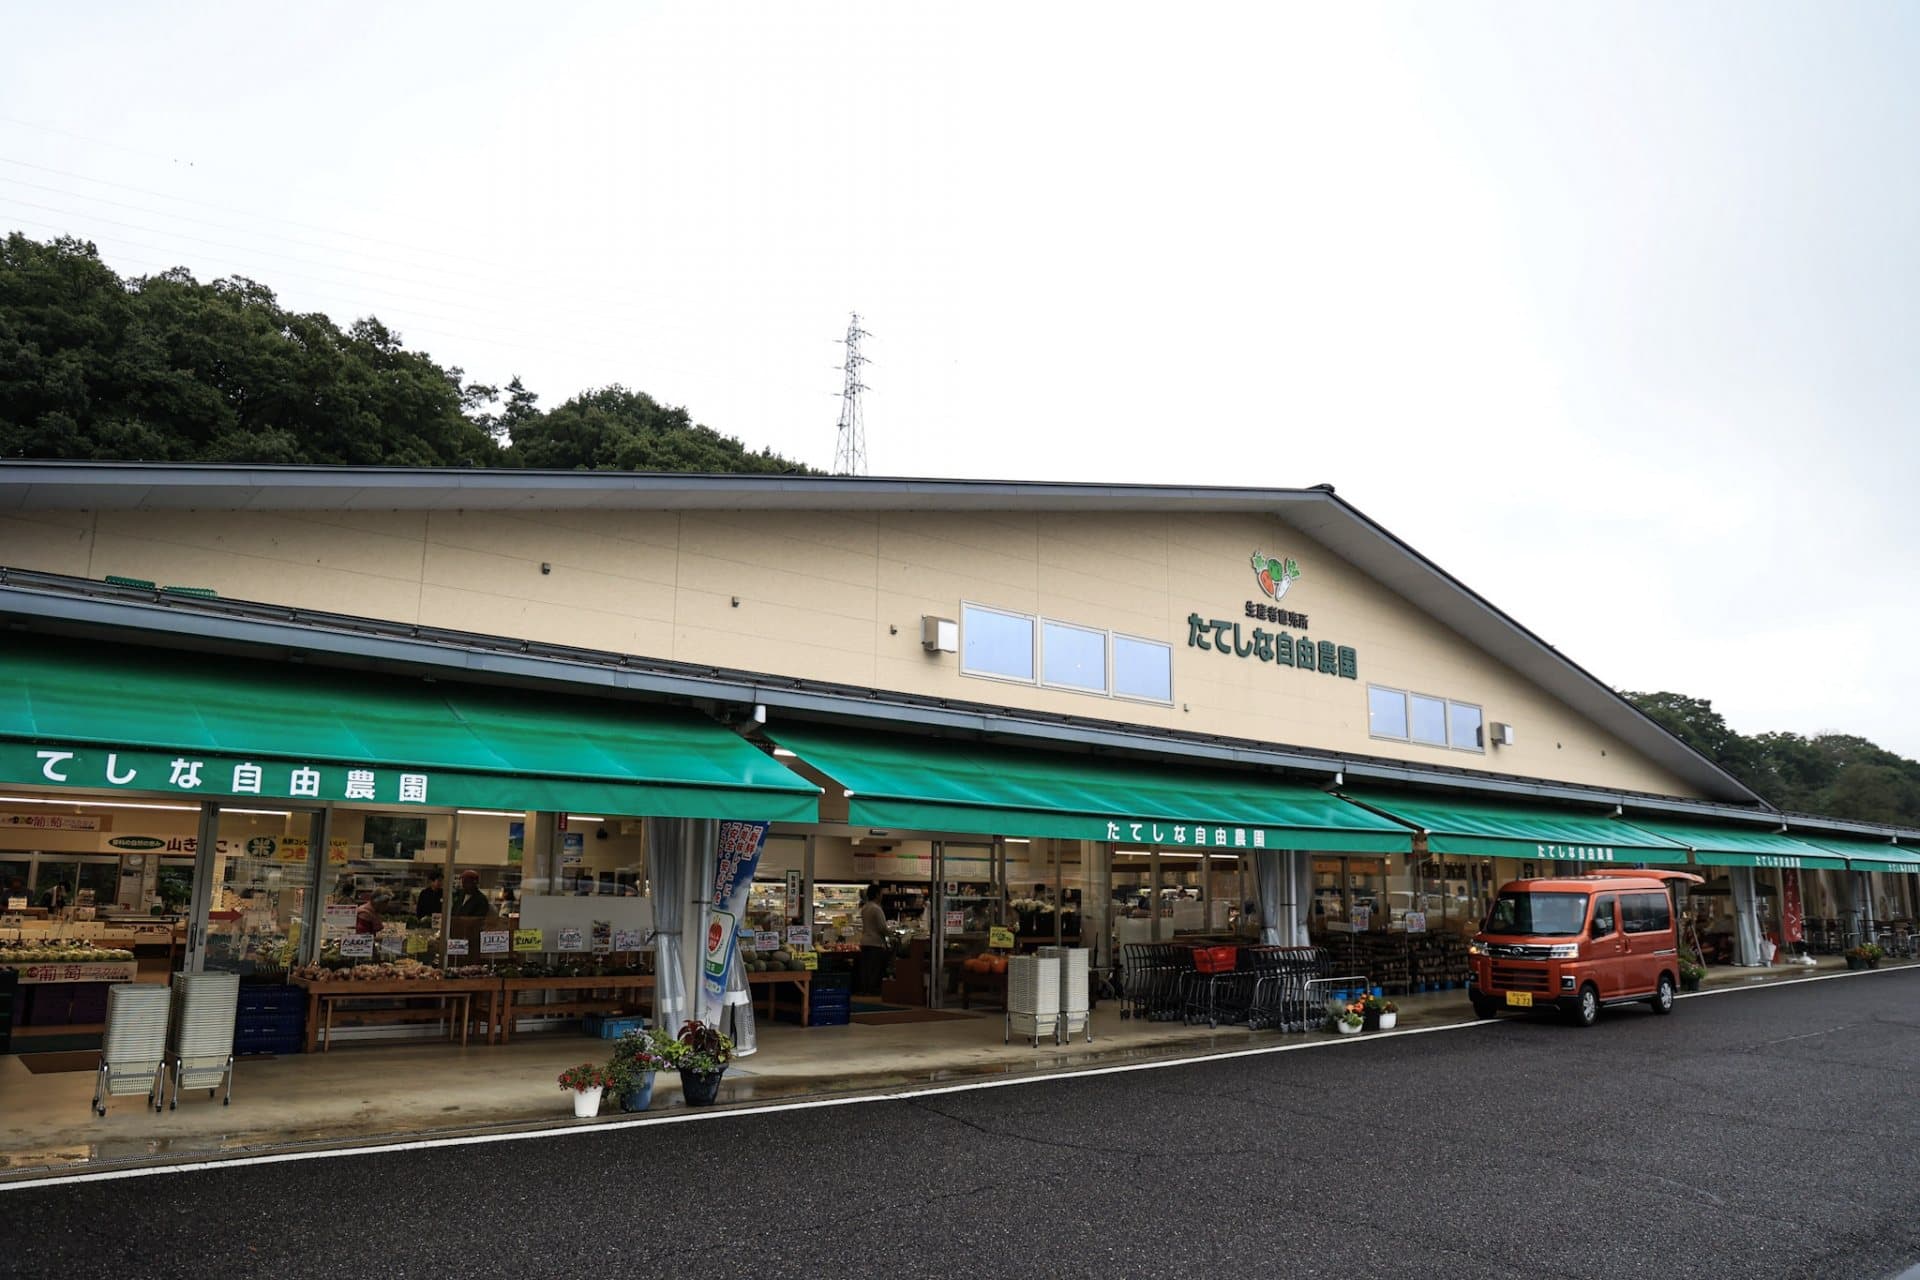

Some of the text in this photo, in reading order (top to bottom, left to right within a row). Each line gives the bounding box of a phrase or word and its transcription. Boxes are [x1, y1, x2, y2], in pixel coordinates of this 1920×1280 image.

[1245, 600, 1308, 630] 生産者直売所
[1188, 612, 1358, 680] たてしな自由農園
[36, 750, 428, 803] てしな自由農園
[1107, 821, 1265, 847] たてしな自由農園
[1537, 844, 1613, 861] たてしな自由農園
